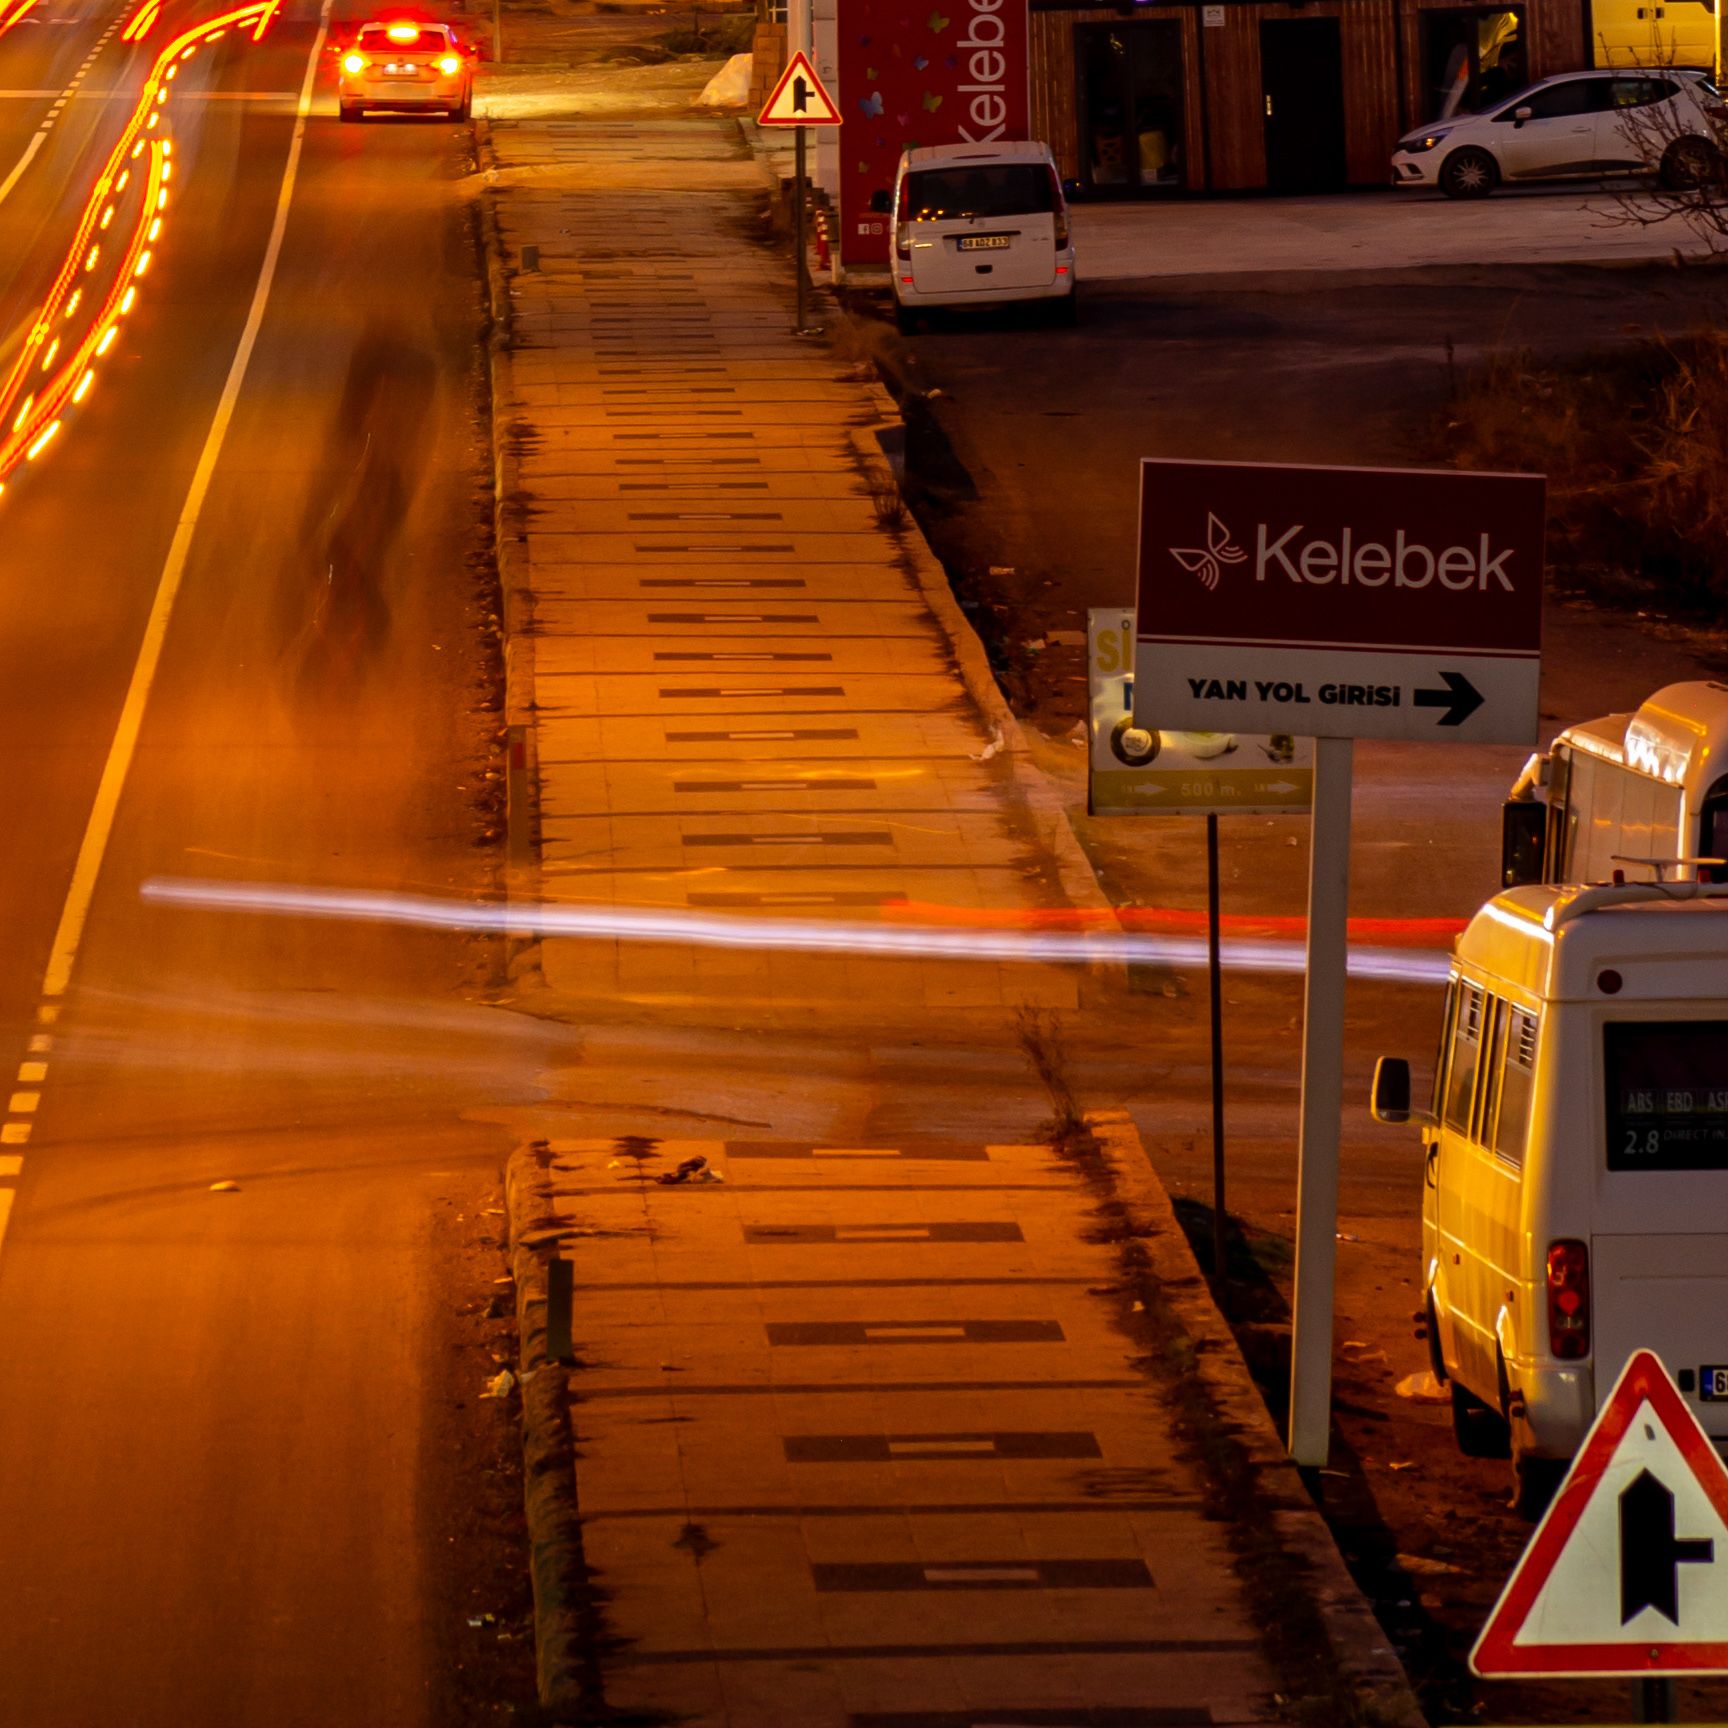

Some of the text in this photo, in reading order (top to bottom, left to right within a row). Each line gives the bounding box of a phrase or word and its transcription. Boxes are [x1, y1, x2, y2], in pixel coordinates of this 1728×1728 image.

[1255, 522, 1516, 593] Kelebek
[1187, 677, 1247, 701] YAN
[1254, 681, 1311, 704] YOL
[1180, 783, 1214, 797] 500
[1627, 1091, 1654, 1113] ABS
[1623, 1129, 1660, 1155] 2.8
